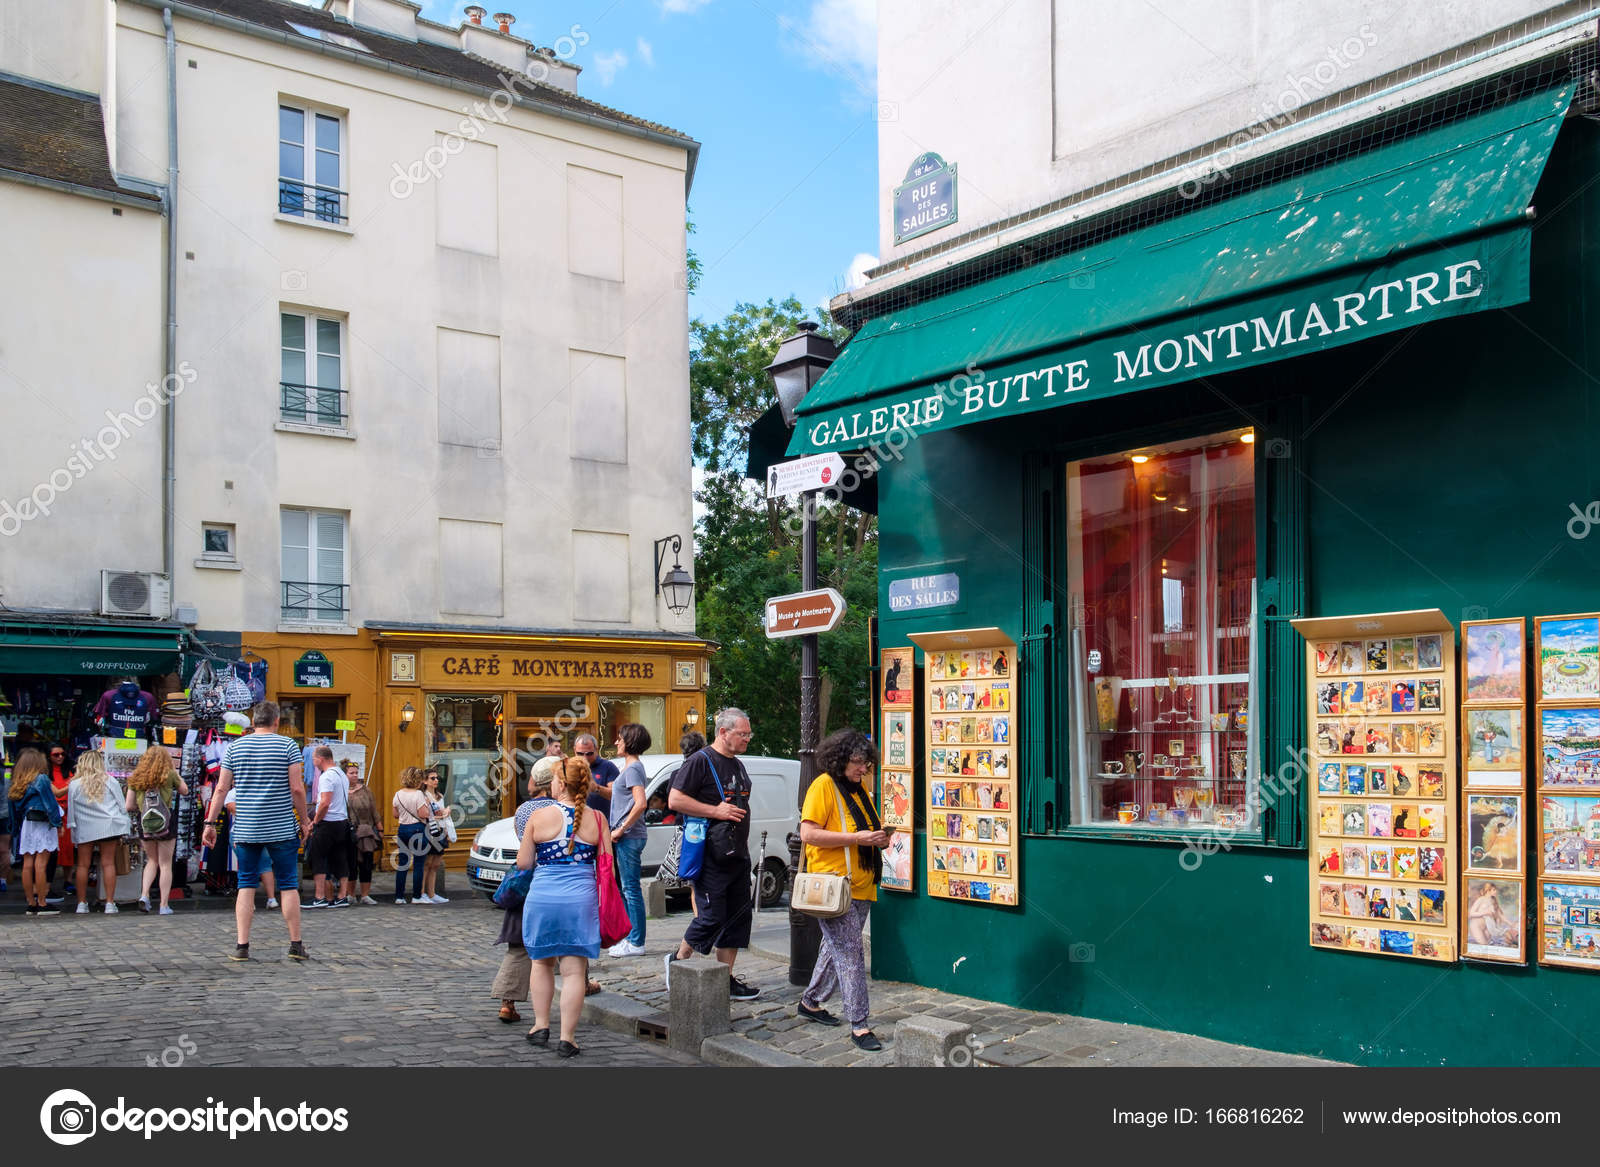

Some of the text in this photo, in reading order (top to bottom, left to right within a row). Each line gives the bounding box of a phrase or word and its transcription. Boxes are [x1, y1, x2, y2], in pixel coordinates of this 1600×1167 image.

[912, 181, 937, 203] RUE
[917, 200, 931, 210] DES
[903, 203, 948, 232] SAULES
[811, 259, 1484, 447] GALERIE BUTTE MONTMARTRE
[912, 576, 936, 590] RUE
[892, 590, 958, 608] DES SAULES
[778, 607, 832, 620] Musée de Montmartre
[95, 662, 149, 670] DIFFUSION
[400, 663, 406, 672] 9
[442, 654, 655, 679] CAFÉ MONTMARTRE
[113, 712, 144, 722] Emirates
[890, 743, 904, 752] ANIS
[890, 756, 904, 765] MONO
